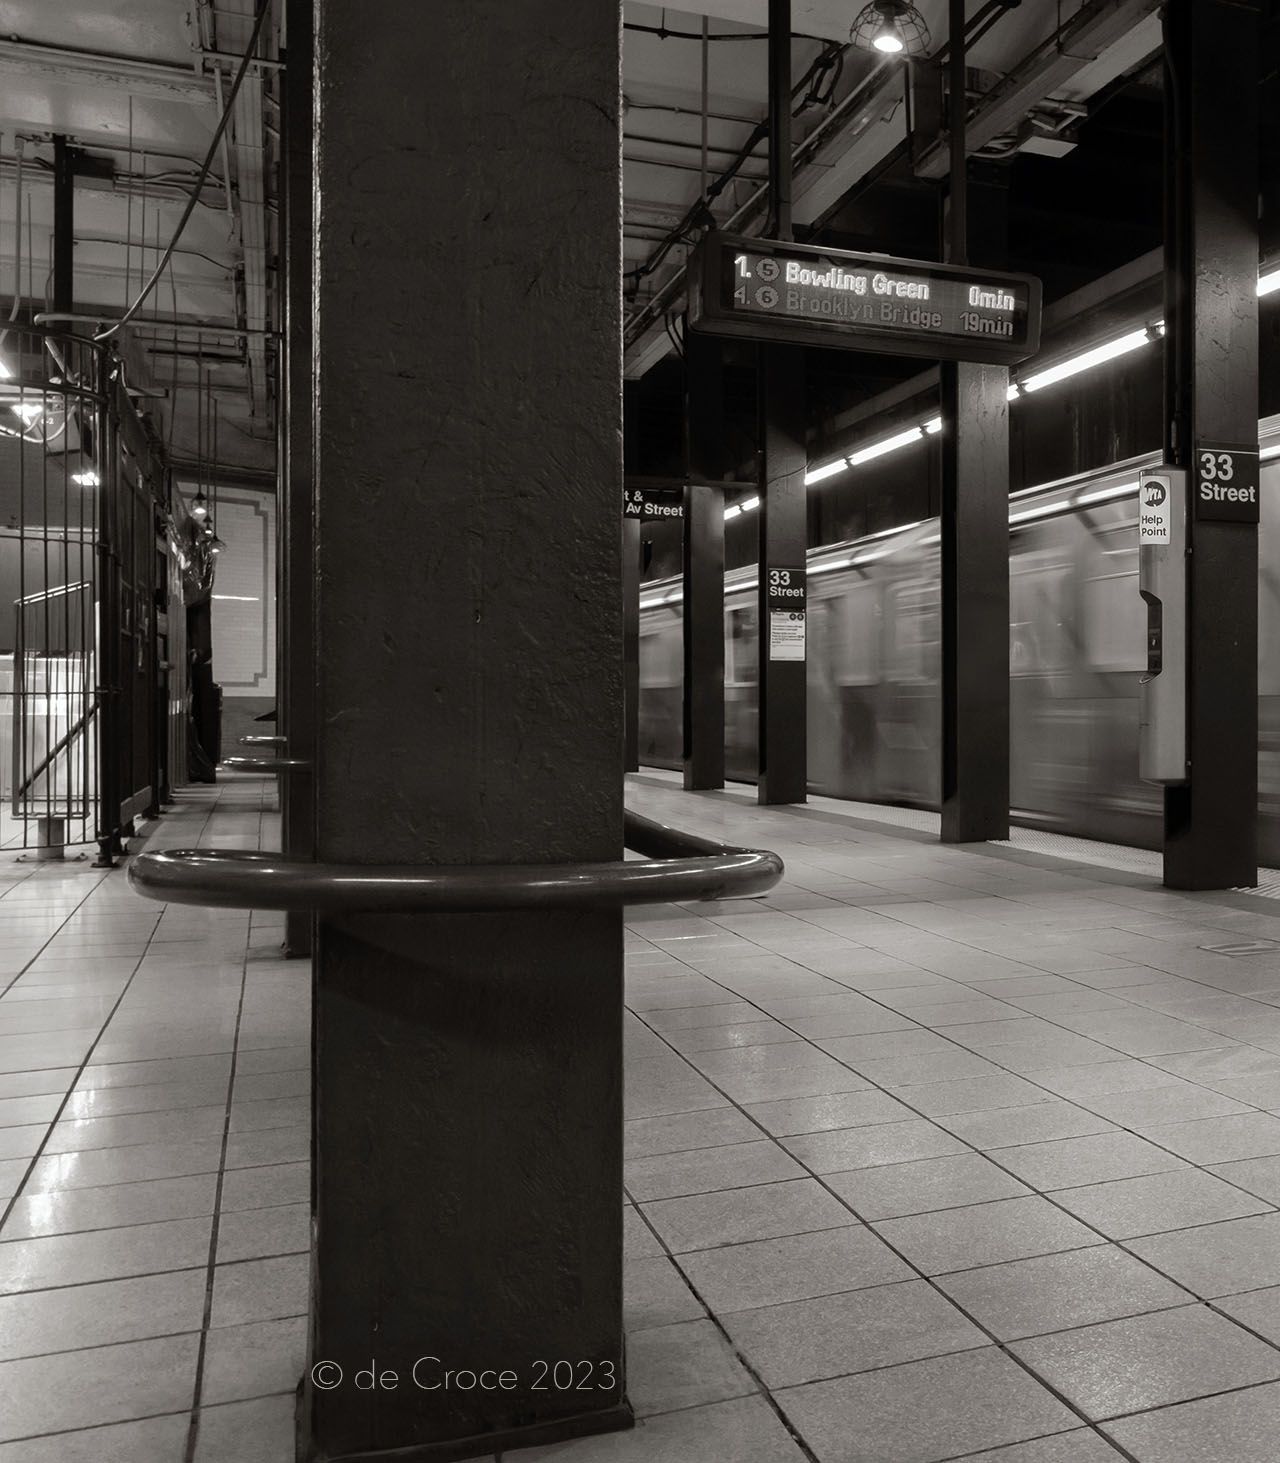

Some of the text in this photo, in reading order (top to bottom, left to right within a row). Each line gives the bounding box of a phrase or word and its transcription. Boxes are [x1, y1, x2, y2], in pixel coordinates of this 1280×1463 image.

[734, 255, 752, 278] 1.
[786, 262, 867, 296] Bowling
[872, 273, 930, 301] Green
[968, 286, 1015, 312] 0min
[786, 290, 873, 321] Brooklyn
[880, 302, 943, 329] Bridge
[959, 311, 1014, 337] 19min
[1200, 452, 1234, 481] 33
[1200, 481, 1256, 503] Street
[626, 502, 684, 517] Av Street
[1141, 514, 1163, 526] Help
[1141, 526, 1167, 537] Point
[769, 570, 791, 586] 33
[769, 586, 804, 597] Street
